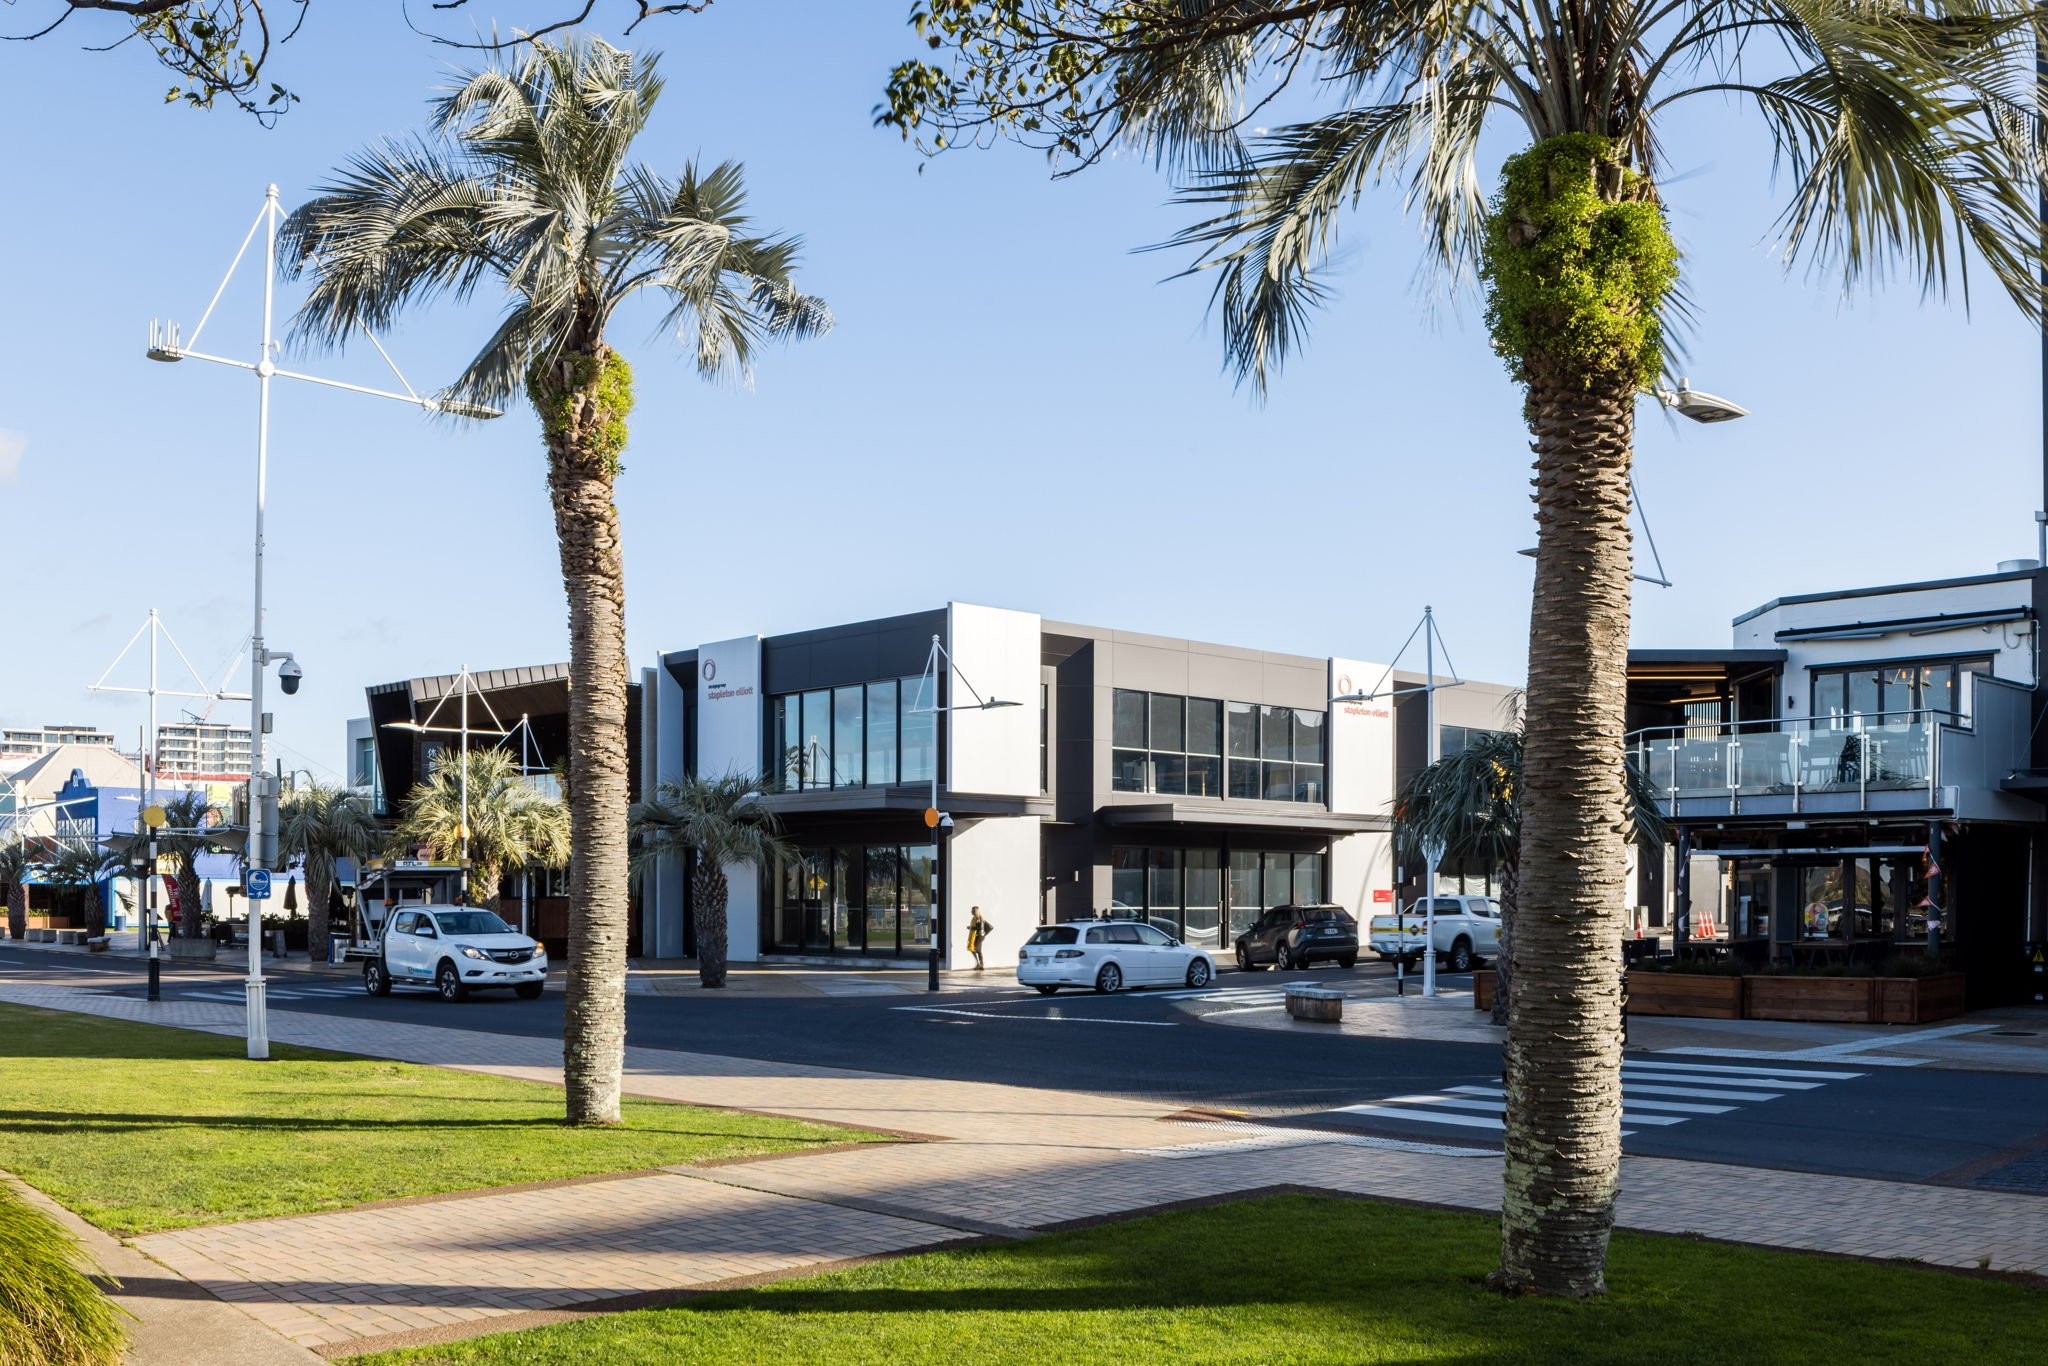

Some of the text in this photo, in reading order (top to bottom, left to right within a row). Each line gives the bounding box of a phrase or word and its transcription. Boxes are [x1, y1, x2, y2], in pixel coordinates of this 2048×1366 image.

[708, 686, 753, 701] stapleton elliott
[1343, 706, 1389, 718] stapleton elliott
